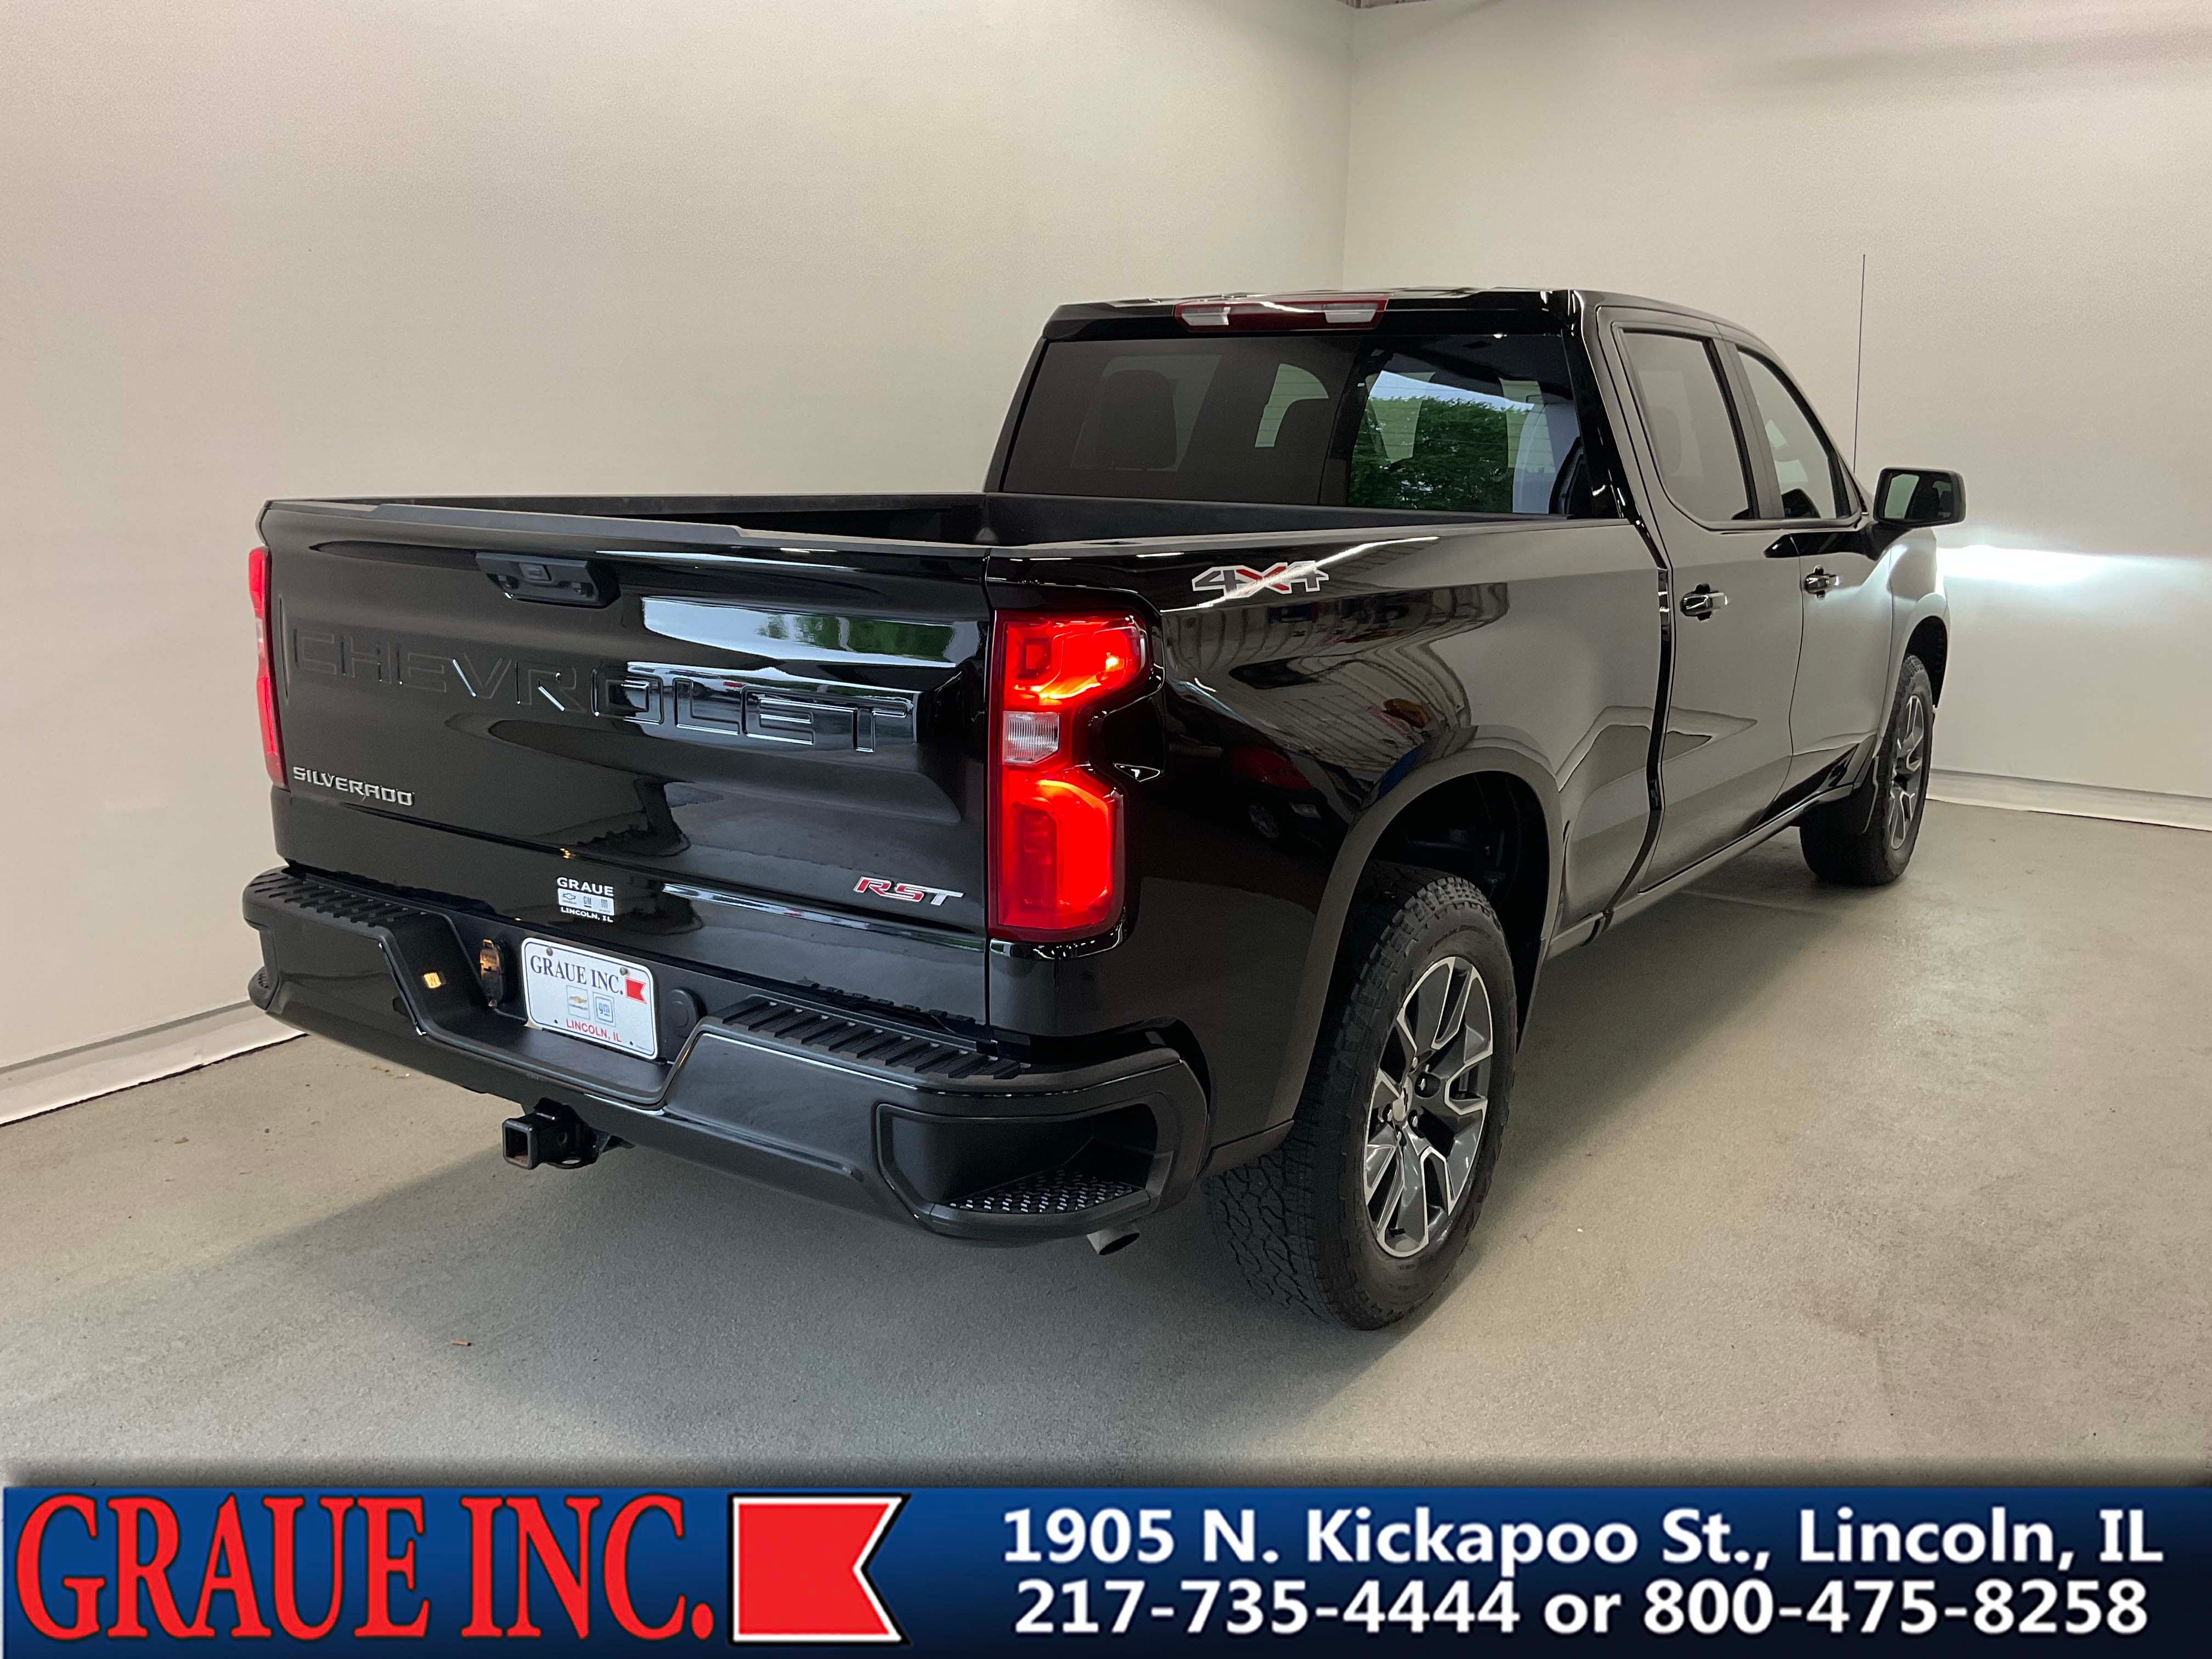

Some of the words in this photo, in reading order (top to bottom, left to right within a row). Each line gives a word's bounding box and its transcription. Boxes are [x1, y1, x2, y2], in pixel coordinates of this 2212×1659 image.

[292, 627, 909, 753] CHEVROLET
[293, 766, 414, 806] SILVERADO
[557, 877, 614, 896] GRAUE
[853, 876, 964, 906] RST
[561, 906, 600, 921] LINCOLN,
[602, 915, 613, 923] IL
[530, 955, 587, 985] GRAUE
[591, 968, 623, 995] INC.
[566, 1018, 611, 1041] LINCOLN,
[613, 1030, 622, 1043] IL
